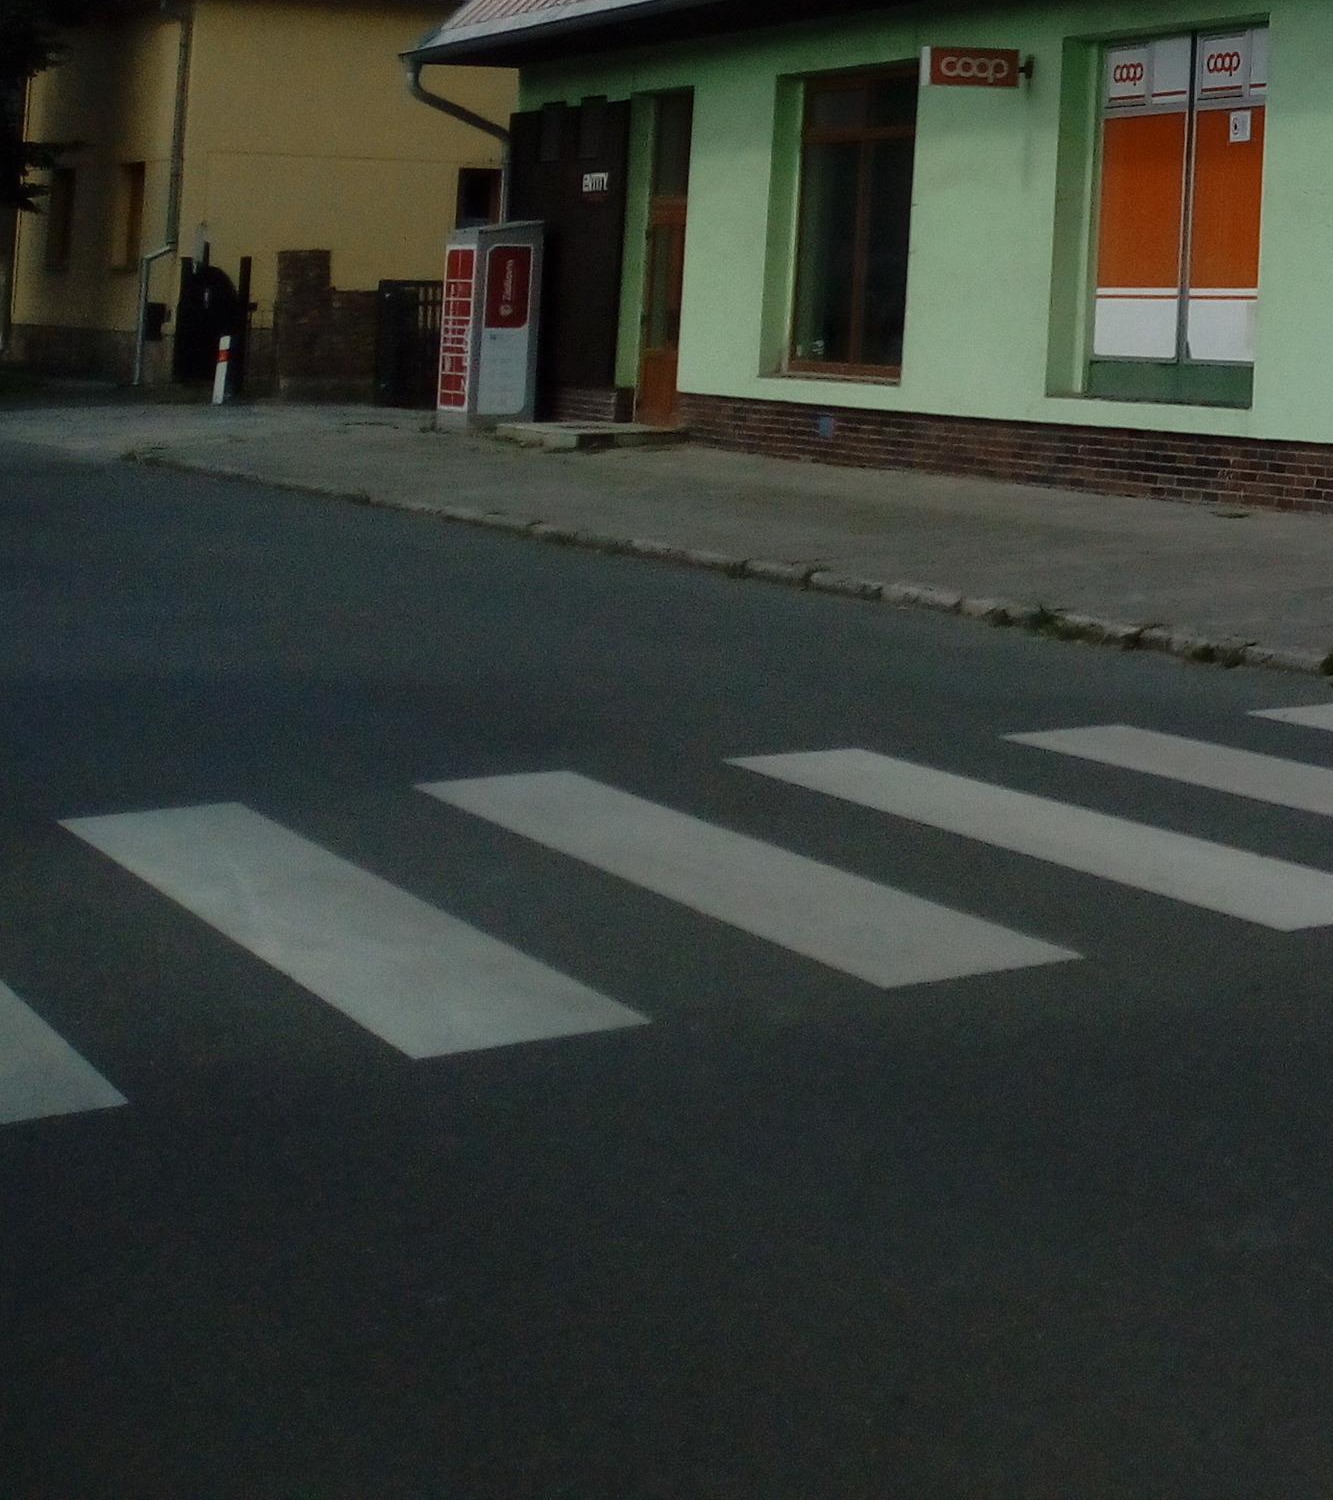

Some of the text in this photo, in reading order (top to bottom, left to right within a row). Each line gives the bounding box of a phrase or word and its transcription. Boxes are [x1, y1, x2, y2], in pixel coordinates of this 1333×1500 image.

[941, 56, 1008, 83] coop
[1114, 63, 1143, 86] coop
[1207, 52, 1240, 76] coop
